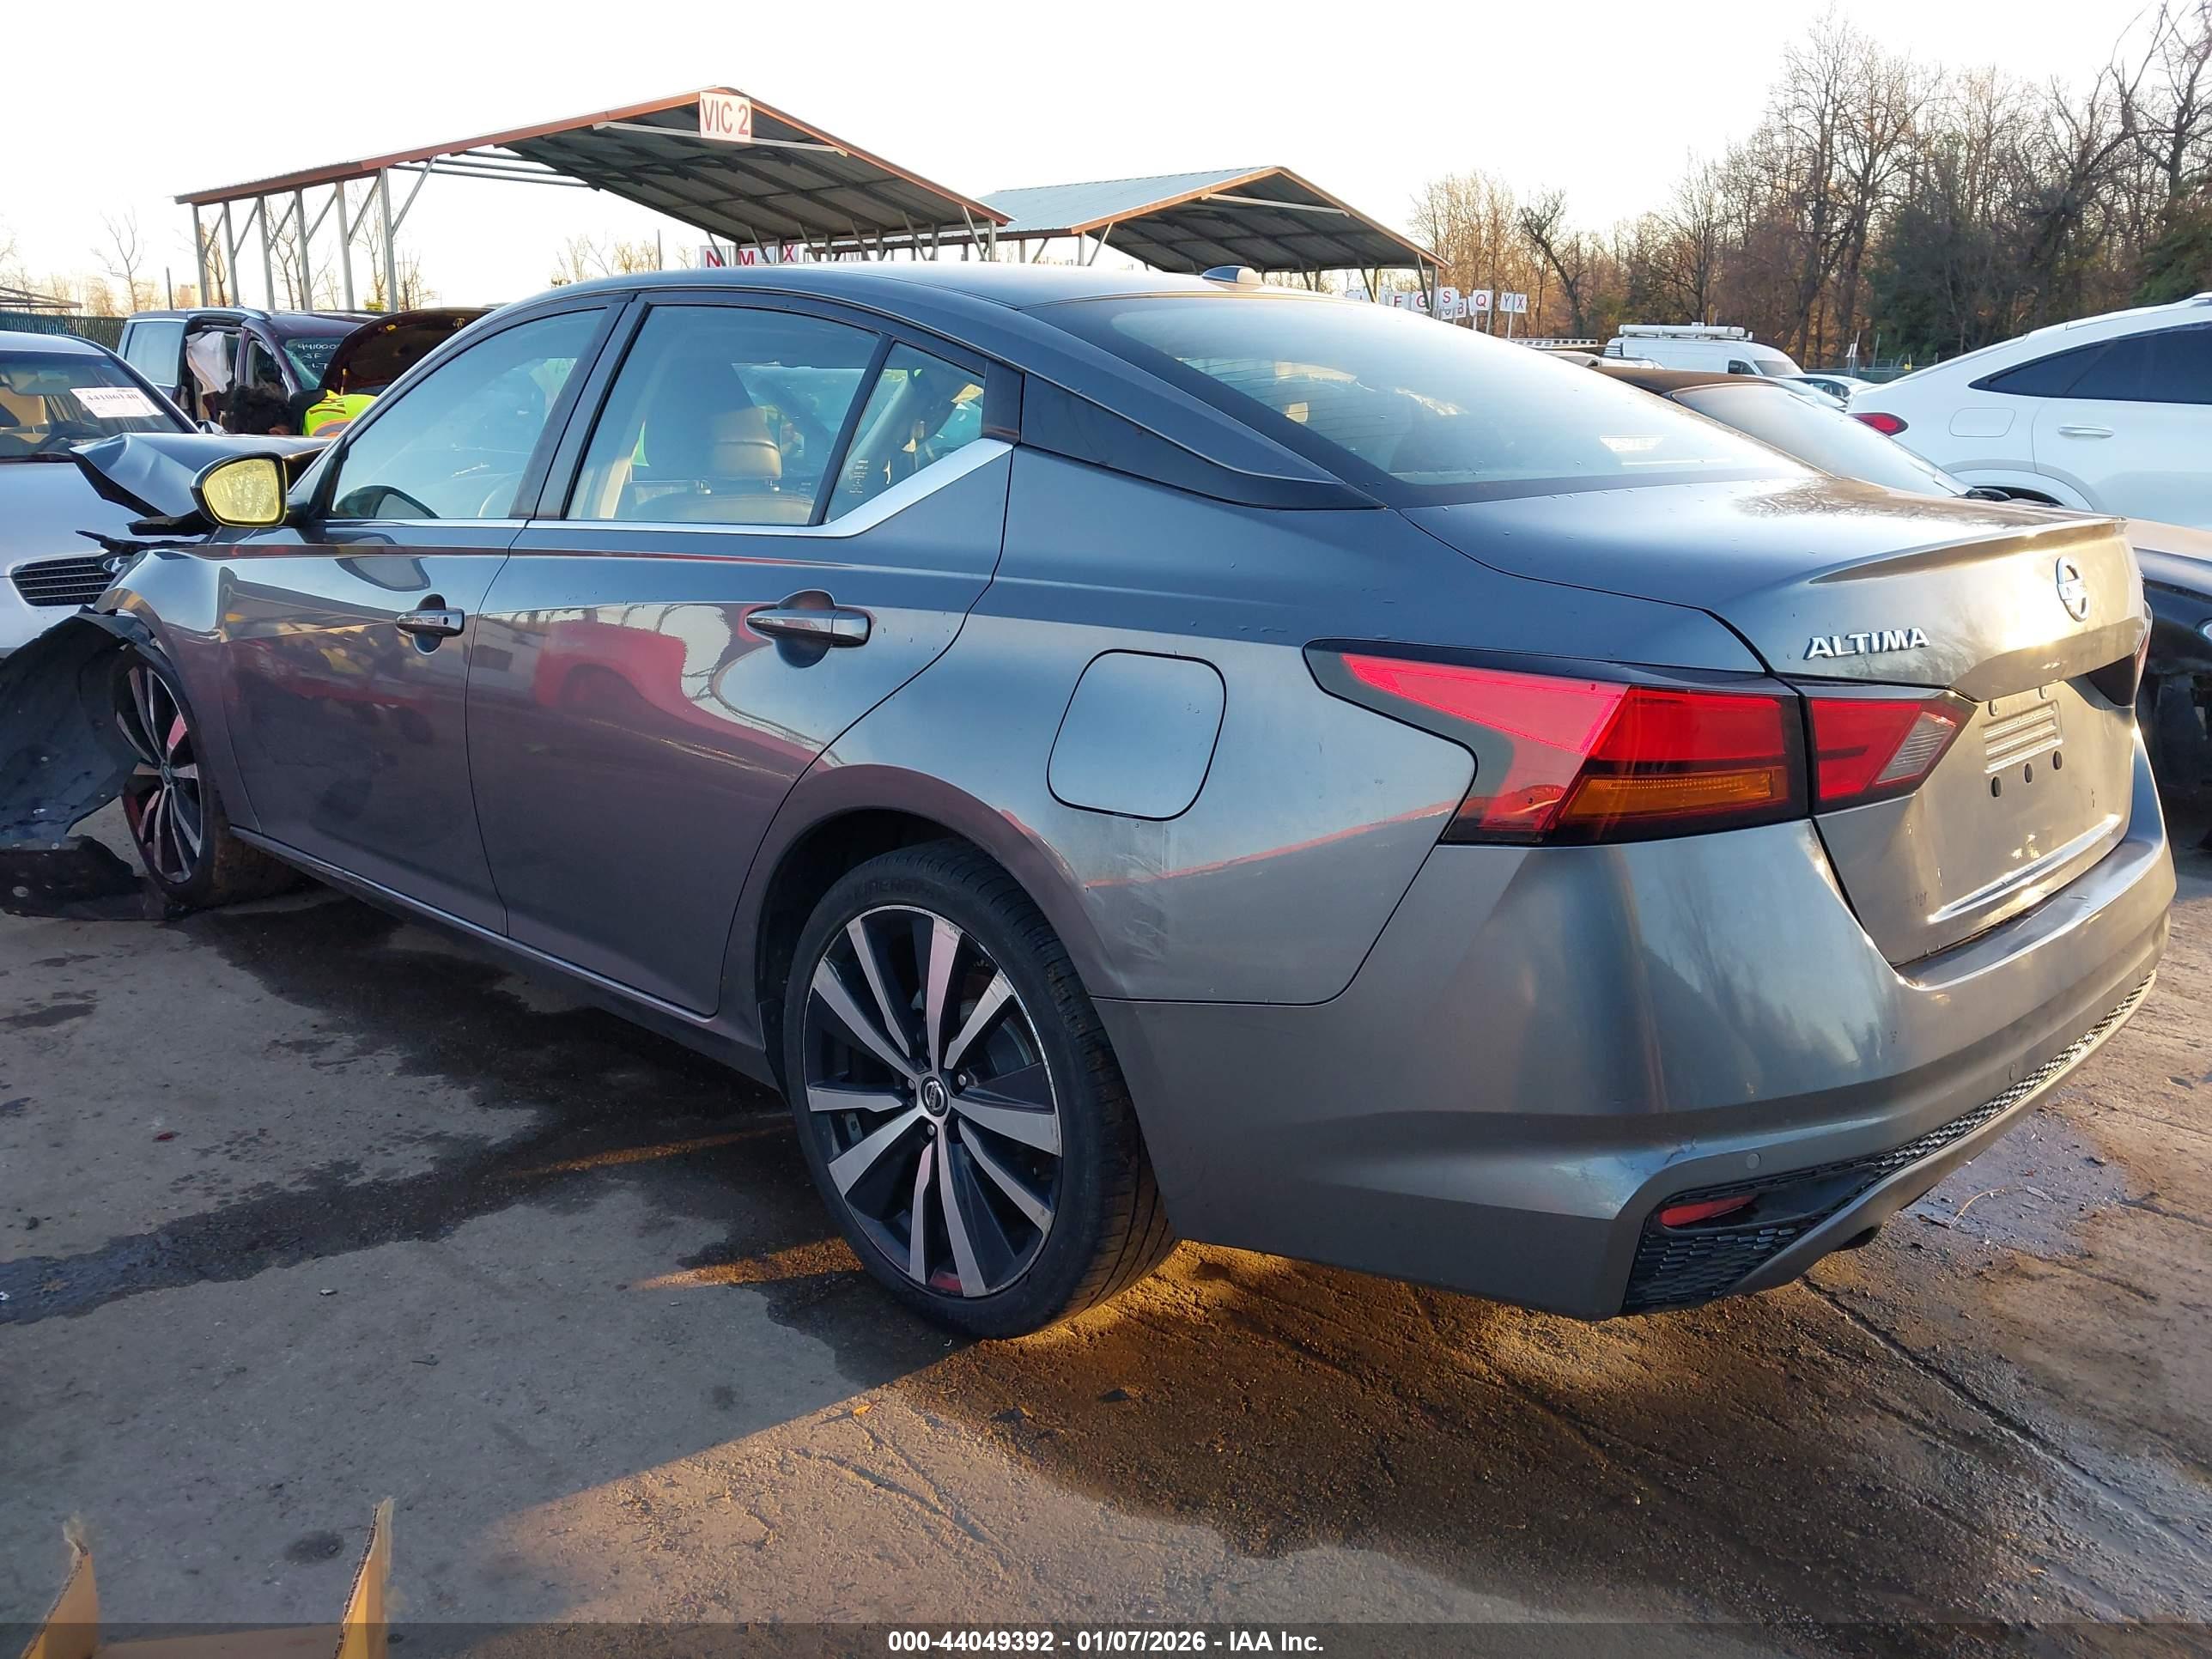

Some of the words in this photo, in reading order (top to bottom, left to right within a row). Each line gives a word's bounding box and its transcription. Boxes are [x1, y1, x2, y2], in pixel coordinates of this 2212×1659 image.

[702, 98, 733, 133] VIC
[738, 103, 749, 135] 2
[706, 250, 721, 267] N
[738, 250, 755, 264] M
[783, 244, 795, 262] X
[1443, 290, 1451, 303] S
[1476, 294, 1486, 307] Q
[1504, 295, 1511, 307] Y
[1516, 296, 1523, 308] X
[1457, 302, 1464, 314] B
[1803, 627, 1930, 660] ALTIMA
